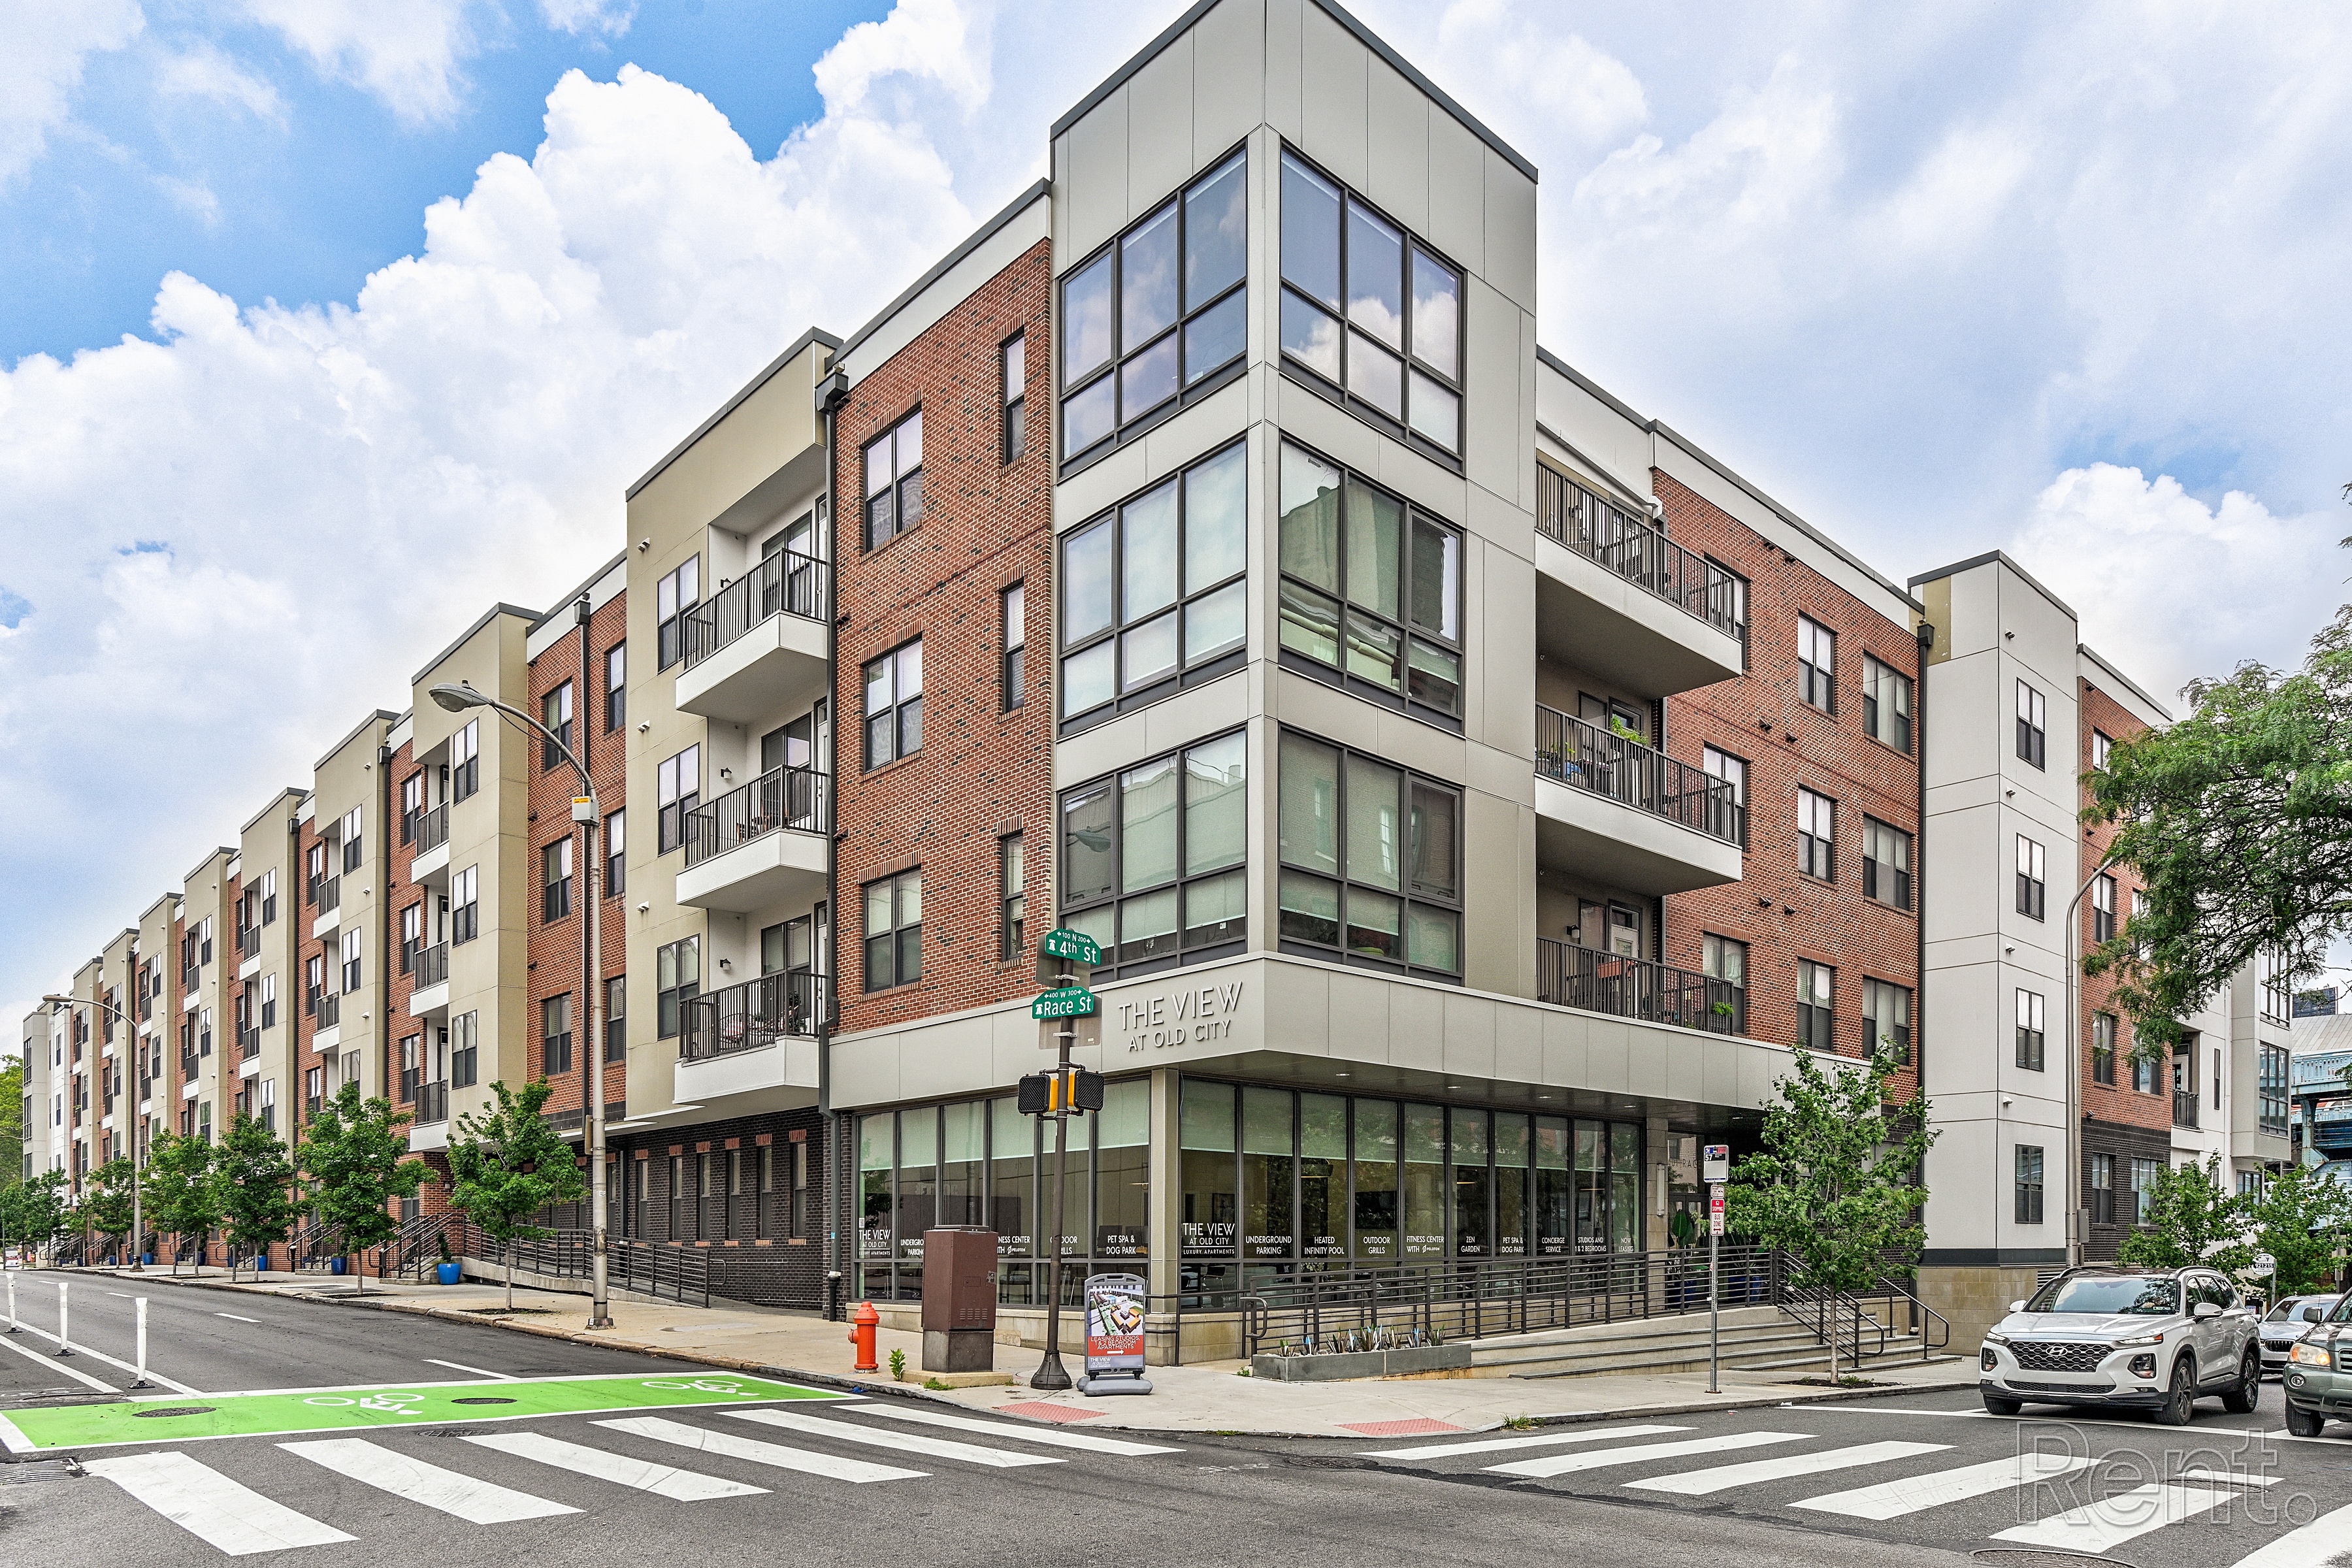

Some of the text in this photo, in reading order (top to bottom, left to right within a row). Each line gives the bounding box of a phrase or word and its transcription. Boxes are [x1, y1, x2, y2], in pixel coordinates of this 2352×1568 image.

[1060, 941, 1096, 963] 4th St
[1044, 996, 1091, 1017] Race St
[1118, 981, 1243, 1030] THE VIEW
[1128, 1019, 1231, 1051] AT OLD CITY
[858, 1230, 891, 1240] THE VIEW
[1183, 1223, 1235, 1236] THE VIEW
[1118, 1235, 1129, 1243] SPA
[1130, 1235, 1135, 1243] &
[1245, 1235, 1292, 1244] UNDERGROUND
[1106, 1246, 1136, 1254] DOG PARK
